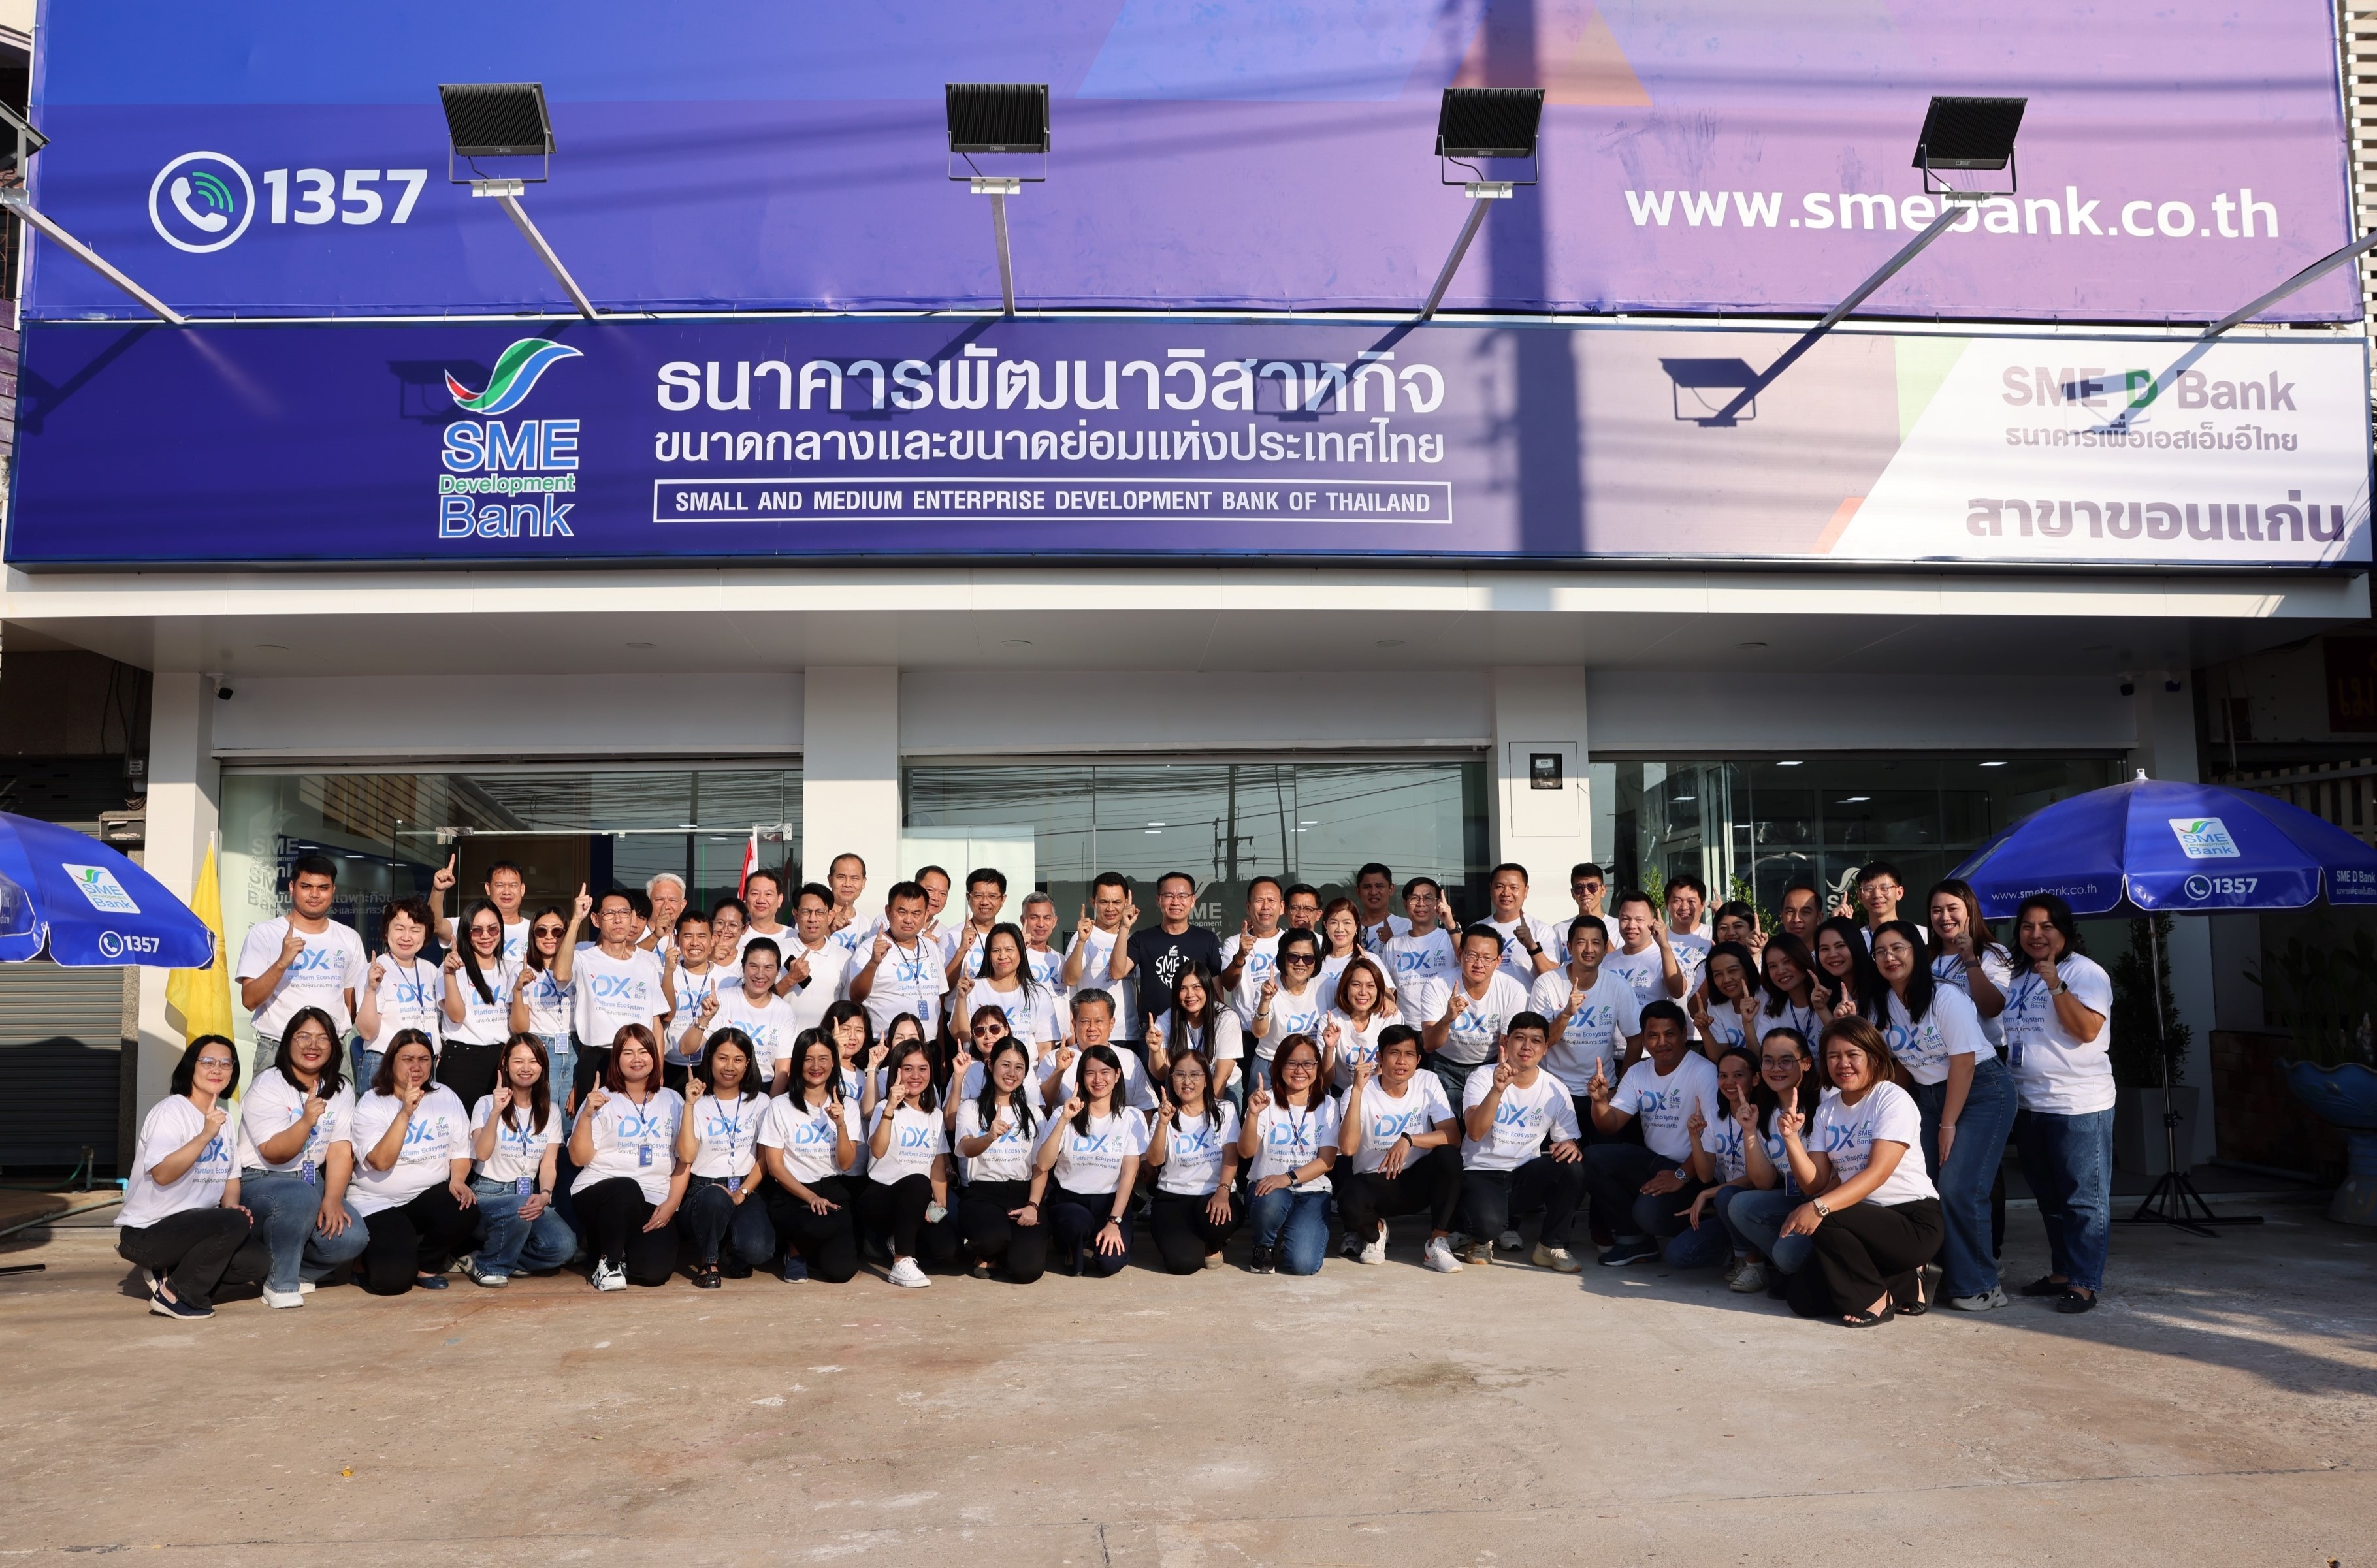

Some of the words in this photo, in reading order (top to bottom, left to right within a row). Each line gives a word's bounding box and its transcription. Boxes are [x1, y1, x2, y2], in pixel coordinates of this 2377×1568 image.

[263, 168, 427, 224] 1357
[1624, 184, 2279, 238] www.smebank.co.th
[657, 344, 1445, 413] ธนาคารพัฒนาวิสาหกิจ
[2001, 366, 2108, 408] SME
[2125, 368, 2158, 408] D
[2176, 369, 2297, 411] Bank
[655, 417, 1445, 464] ขนาดกลางและขนาดย่อมแห่งประเทศไทย
[2005, 413, 2298, 451] ธนาคารเพื่อเอสเอ็มอีไทย
[442, 419, 581, 472] SME
[439, 473, 576, 497] Development
[676, 492, 748, 511] SMALL
[758, 492, 802, 509] AND
[814, 491, 901, 509] MEDIUM
[914, 491, 1044, 509] ENTERPRISE
[1056, 491, 1212, 509] DEVELOPMENT
[1223, 492, 1279, 509] BANK
[1290, 492, 1316, 510] OF
[1326, 492, 1430, 512] THAILAND
[438, 494, 575, 539] Bank
[1966, 490, 2345, 543] สาขาขอนแก่น
[251, 837, 299, 854] SME
[2183, 833, 2229, 843] SME
[2188, 846, 2234, 855] Bank
[2212, 878, 2257, 893] 1357
[2337, 870, 2351, 882] SME
[2352, 871, 2358, 882] D
[2359, 871, 2376, 883] Bank
[82, 883, 124, 896] SME
[93, 897, 134, 910] Bank
[1189, 902, 1222, 919] ME
[123, 935, 160, 953] 1357
[1397, 949, 1431, 973] DX
[896, 962, 928, 982] DX
[592, 974, 631, 999] DX
[617, 1002, 645, 1012] Ecosystem
[1450, 1012, 1487, 1033] DX
[1449, 1031, 1474, 1040] Platform
[1924, 1034, 1941, 1044] SME
[1926, 1042, 1943, 1051] Bank
[1494, 1102, 1529, 1128] DX
[1655, 1113, 1679, 1122] Ecosystem
[618, 1115, 662, 1138] DX
[795, 1123, 831, 1144] DX
[1269, 1123, 1310, 1146] DX
[421, 1143, 449, 1153] Ecosystem
[901, 1126, 931, 1149] DX
[1073, 1134, 1108, 1153] DX
[1175, 1131, 1211, 1155] DX
[1826, 1122, 1859, 1153] DX
